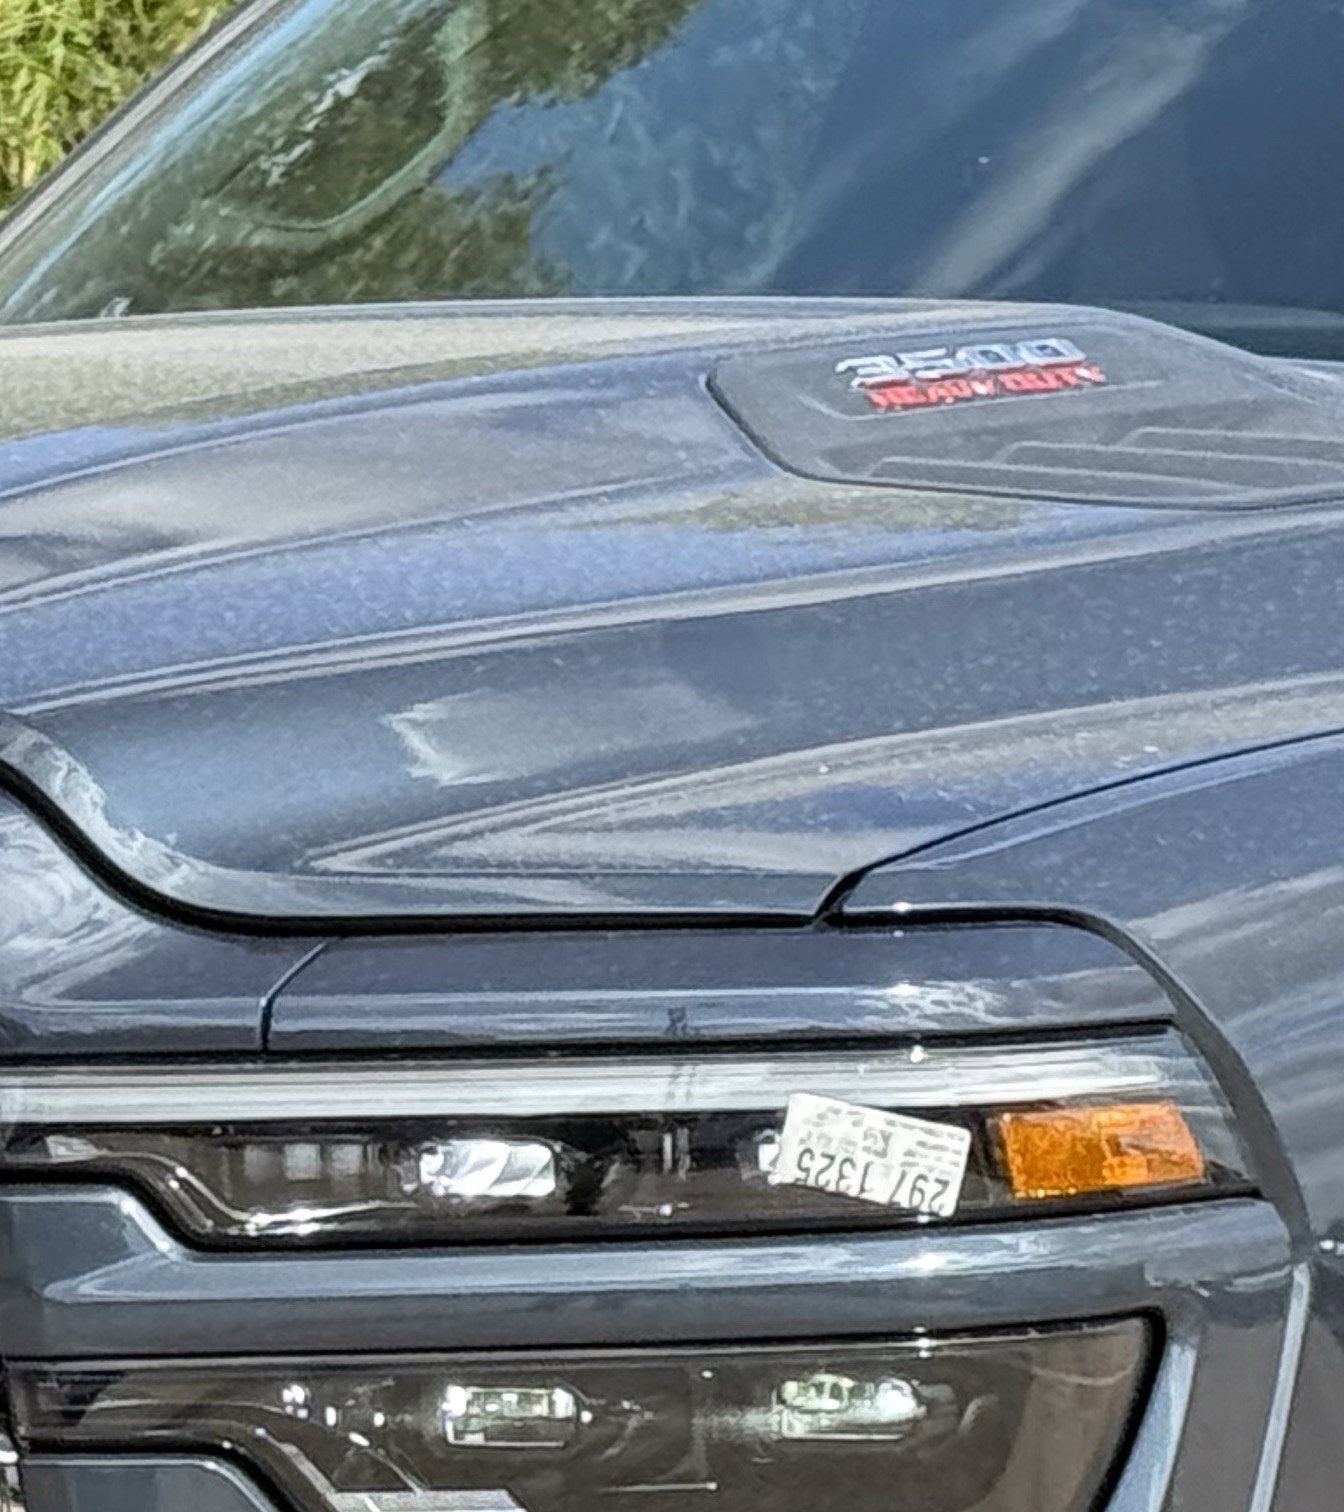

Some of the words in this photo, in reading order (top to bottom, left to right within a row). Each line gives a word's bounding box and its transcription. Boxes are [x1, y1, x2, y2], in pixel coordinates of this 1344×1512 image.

[835, 337, 1087, 388] 3500
[793, 1147, 874, 1196] 1325
[888, 1168, 951, 1214] 297
